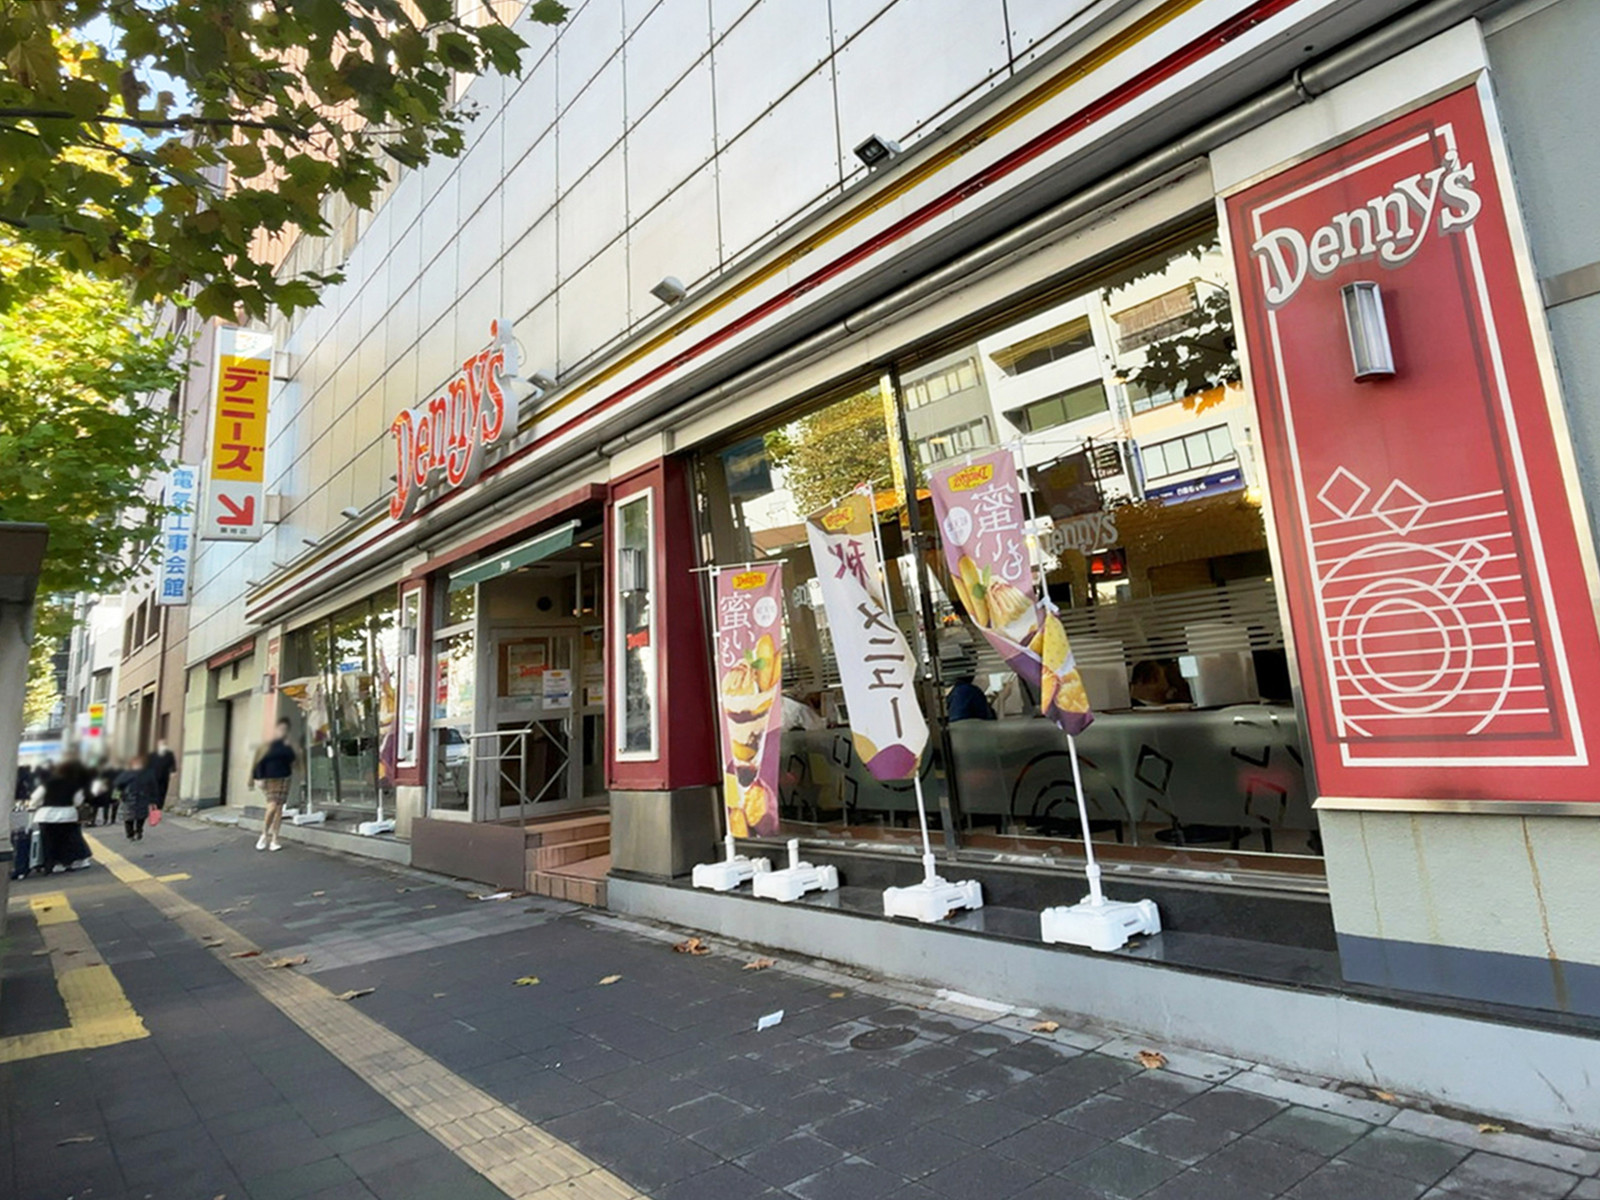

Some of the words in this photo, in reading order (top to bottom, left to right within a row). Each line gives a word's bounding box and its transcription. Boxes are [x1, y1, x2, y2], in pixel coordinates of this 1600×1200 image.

[1252, 149, 1482, 306] Denny's
[217, 366, 270, 472] デニーズ
[389, 318, 505, 521] Denny's
[720, 591, 756, 668] 蜜いも
